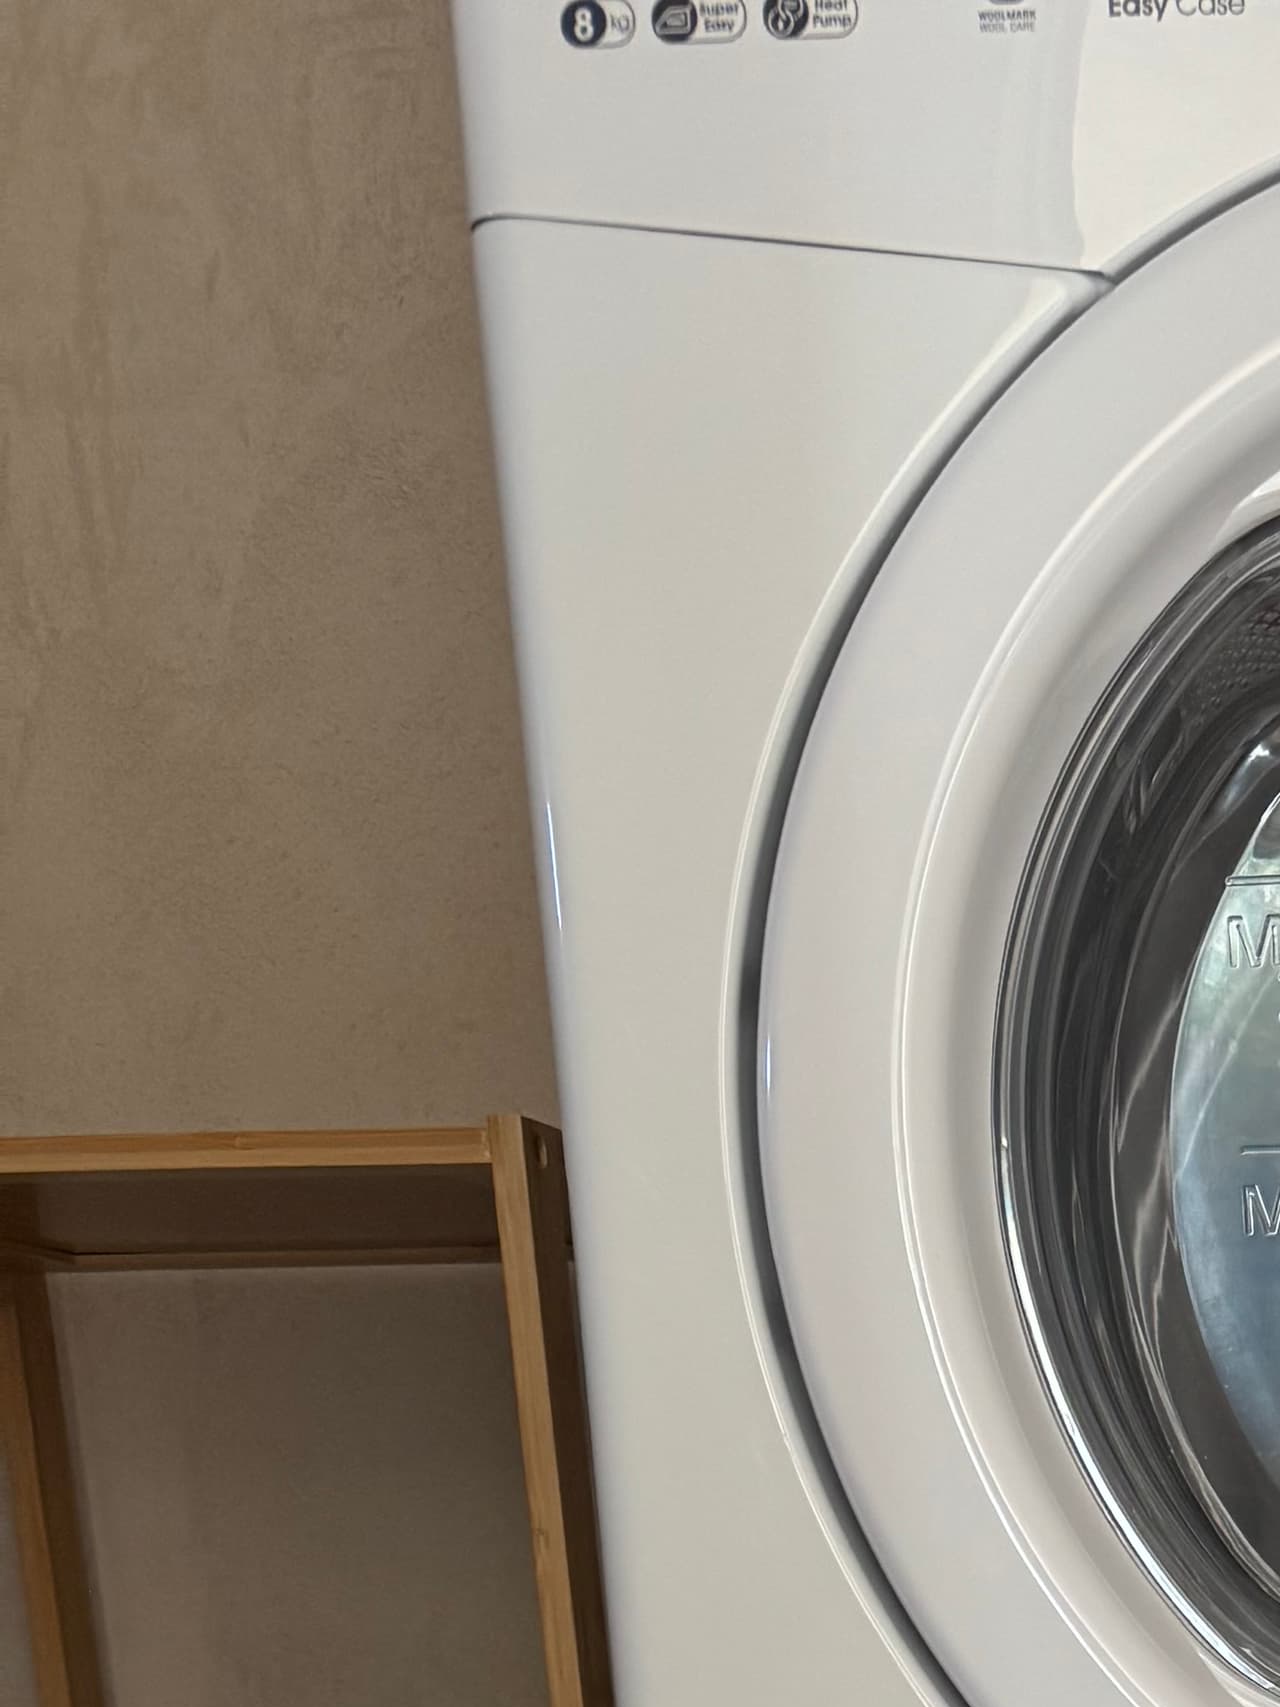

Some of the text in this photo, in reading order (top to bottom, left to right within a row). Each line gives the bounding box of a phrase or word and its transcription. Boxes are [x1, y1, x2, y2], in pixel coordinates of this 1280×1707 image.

[573, 8, 629, 42] 8 kg
[1108, 0, 1246, 22] Easy Case
